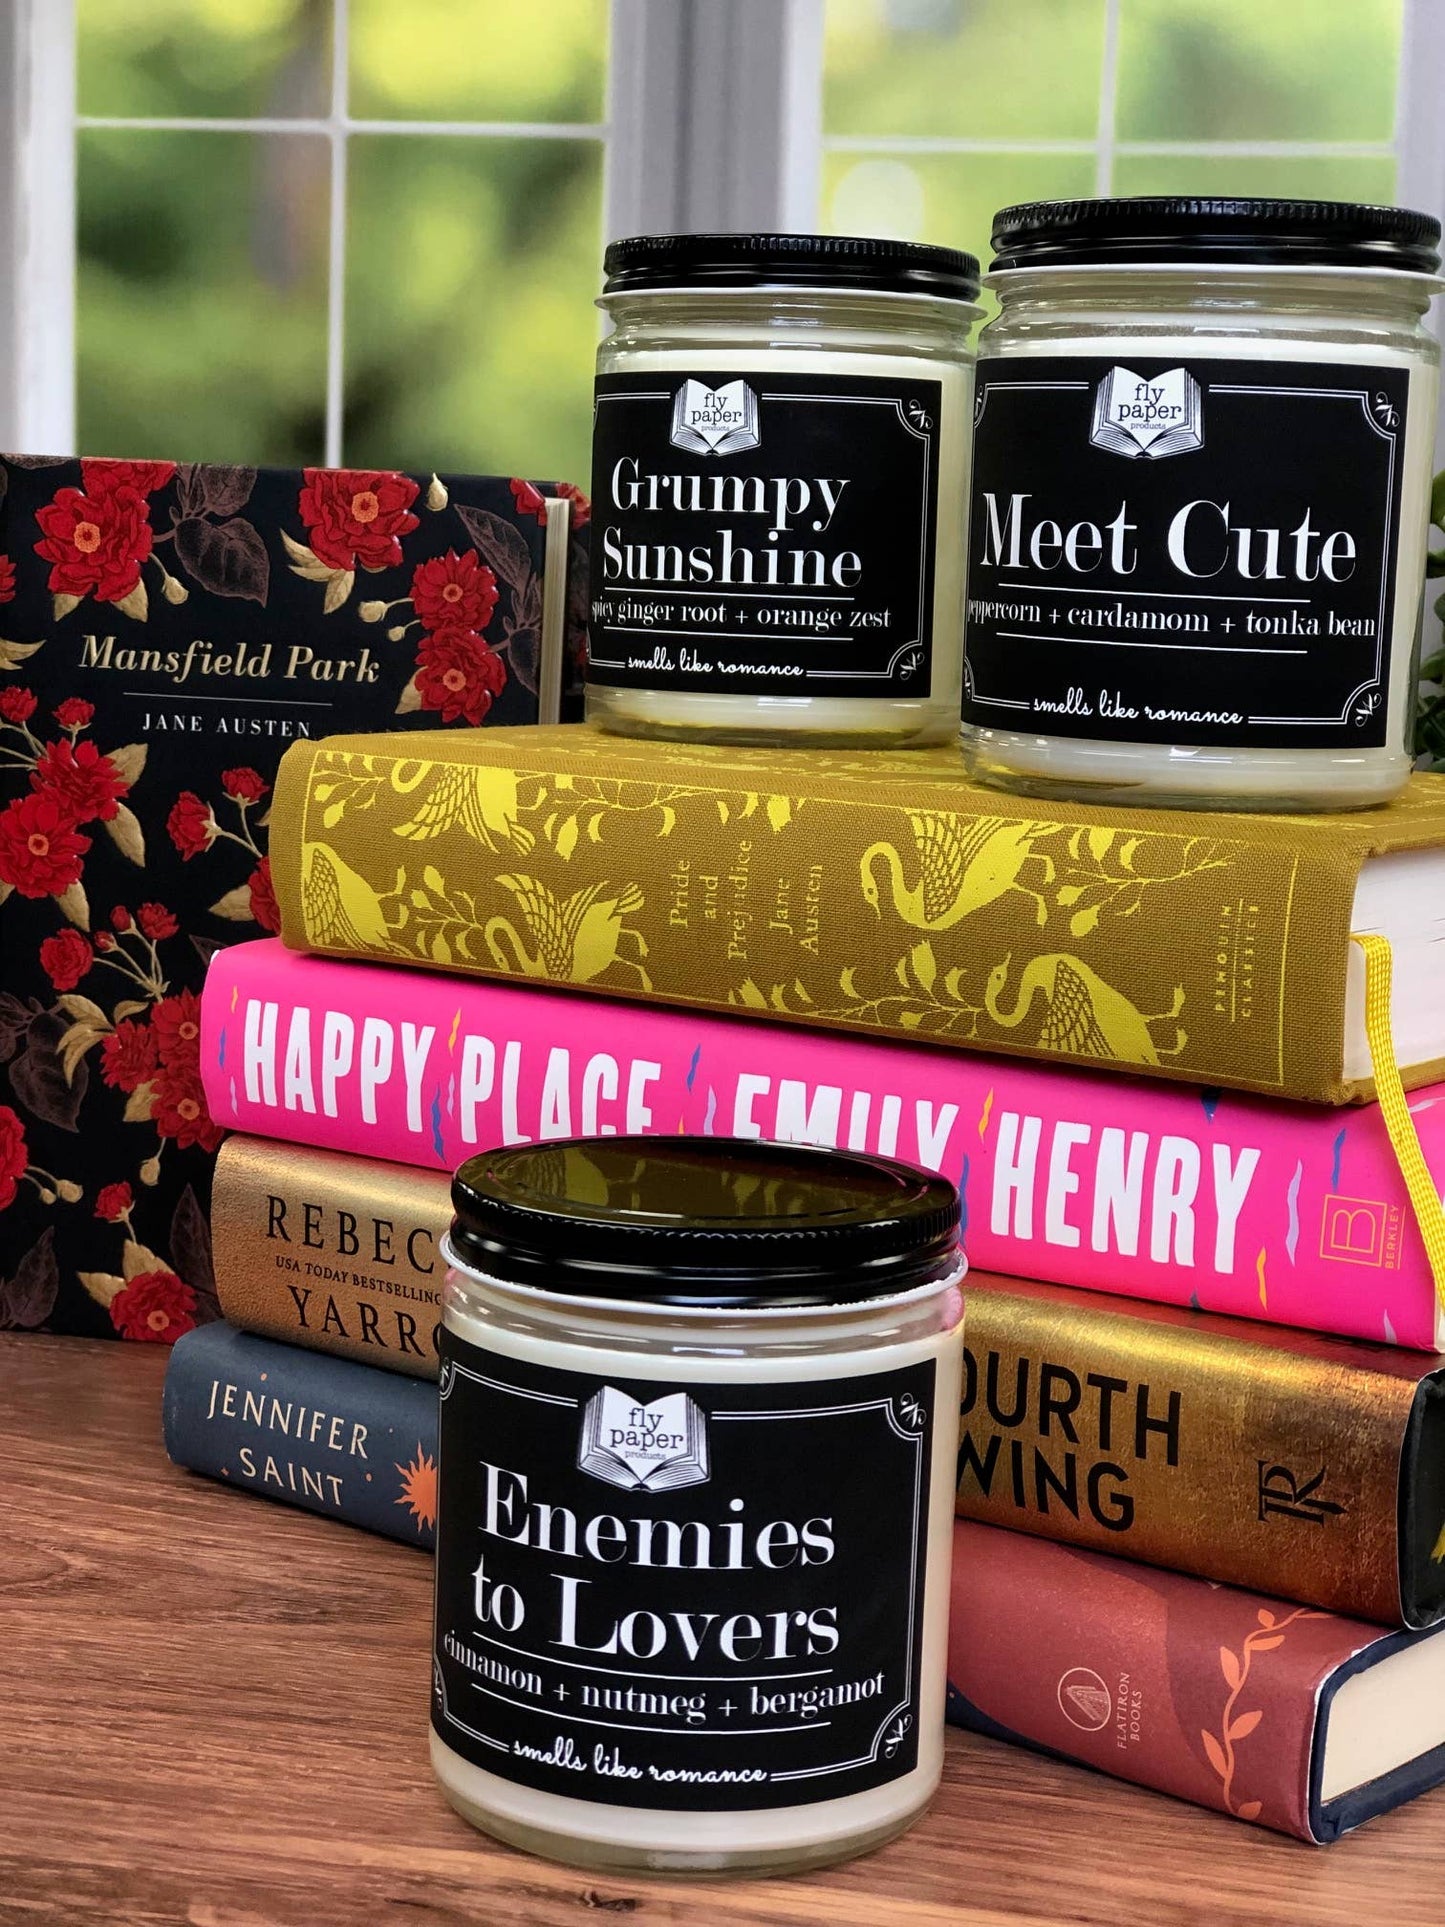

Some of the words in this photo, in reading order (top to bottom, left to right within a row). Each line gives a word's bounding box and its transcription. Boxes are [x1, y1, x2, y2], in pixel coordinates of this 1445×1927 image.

[691, 409, 742, 425] paper
[703, 392, 728, 411] fly
[1118, 403, 1182, 422] paper
[1134, 383, 1166, 406] fly
[1130, 422, 1166, 430] products
[611, 456, 851, 532] Grumpy
[603, 526, 863, 588] Sunshine
[980, 493, 1138, 575] Meet
[1167, 500, 1357, 583] Cute
[617, 597, 675, 626] ginger
[681, 601, 728, 624] root
[757, 608, 842, 632] orange
[849, 608, 892, 628] zest
[967, 598, 1041, 625] peppercorn
[1067, 603, 1209, 632] cardamom
[1246, 608, 1321, 636] tonka
[1328, 611, 1376, 638] bean
[79, 634, 272, 683] Mansfield
[285, 646, 381, 683] Park
[628, 646, 676, 671] smells
[680, 647, 713, 673] like
[717, 662, 804, 677] romance
[142, 712, 204, 734] JANE
[216, 716, 312, 738] AUSTEN
[1034, 686, 1093, 716] smells
[1100, 689, 1140, 719] like
[1144, 706, 1243, 724] romance
[670, 860, 691, 929] Pride
[700, 875, 718, 919] and
[727, 840, 753, 960] Prejudice
[769, 877, 793, 935] Jane
[800, 864, 823, 956] Austen
[244, 998, 437, 1134] HAPPY
[461, 1034, 662, 1146] PLACE
[990, 1112, 1261, 1274] HENRY
[266, 1194, 452, 1275] REBEC
[1385, 1205, 1399, 1269] BERKLEY
[275, 1255, 301, 1273] USA
[305, 1262, 349, 1284] TODAY
[207, 1380, 369, 1460] JENNIFER
[610, 1428, 684, 1451] paper
[629, 1407, 663, 1434] fly
[239, 1447, 344, 1506] SAINT
[956, 1431, 1135, 1531] WING
[478, 1461, 836, 1570] Enemies
[471, 1552, 526, 1632] to
[548, 1573, 840, 1663] Lovers
[444, 1629, 544, 1697] cinnamon
[581, 1677, 706, 1726] nutmeg
[750, 1671, 885, 1720] bergamot
[1117, 1671, 1131, 1750] FLATIRON
[1130, 1690, 1143, 1741] BOOKS
[513, 1735, 586, 1772] smells
[594, 1742, 643, 1781] like
[649, 1764, 768, 1785] romance
